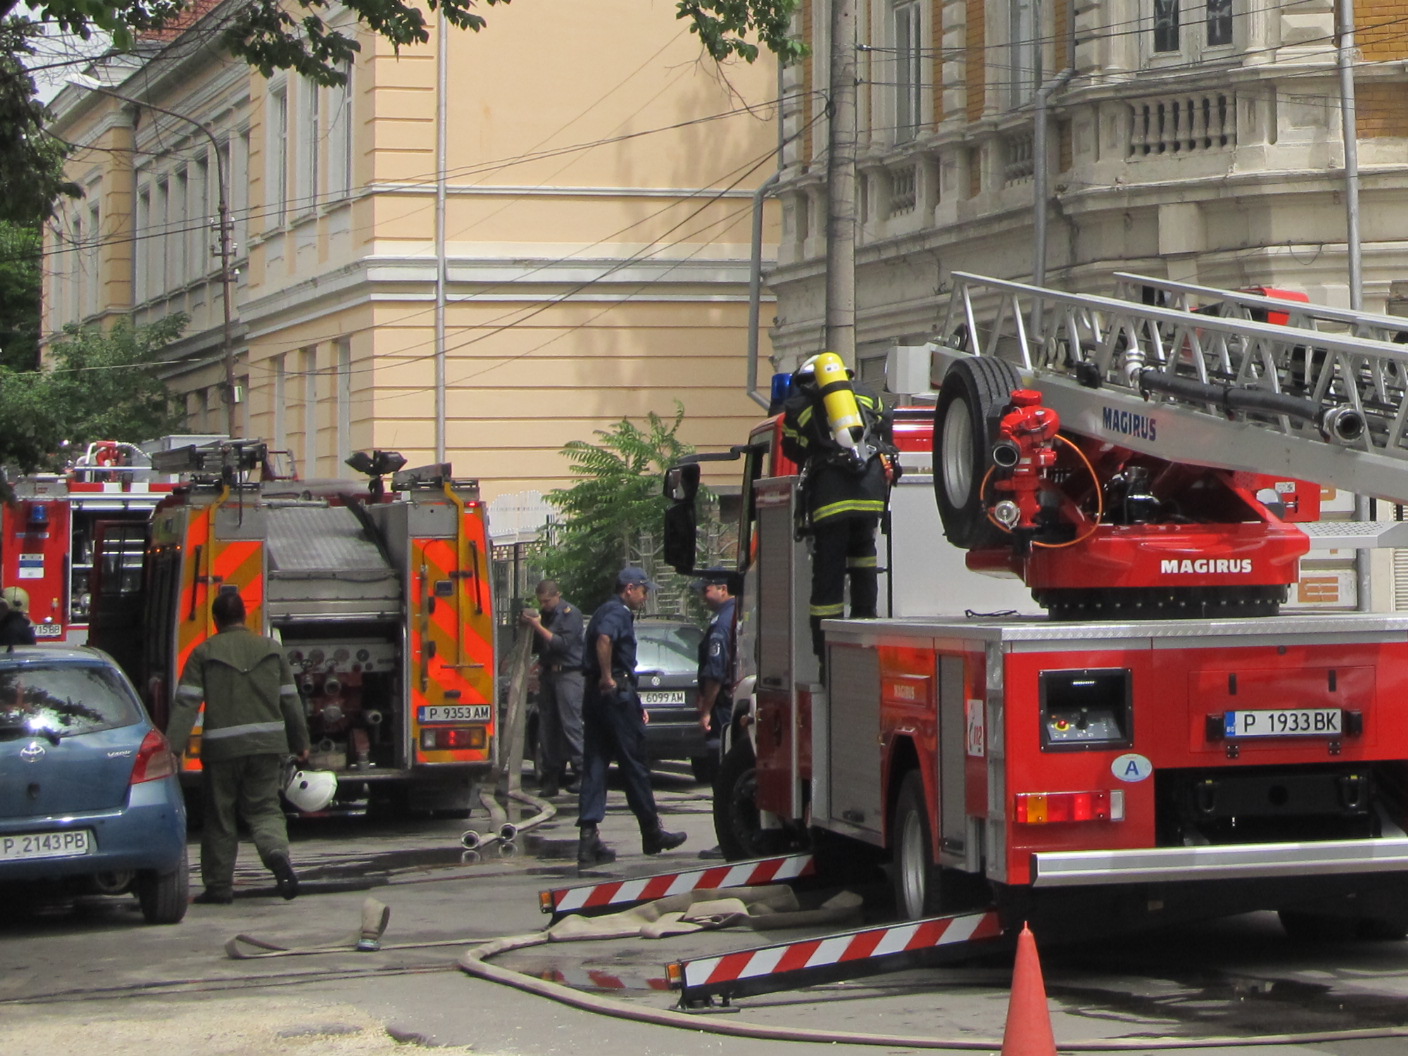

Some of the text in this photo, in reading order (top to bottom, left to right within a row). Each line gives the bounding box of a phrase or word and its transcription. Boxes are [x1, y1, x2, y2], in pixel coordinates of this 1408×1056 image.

[1102, 406, 1157, 442] MAGIRUS
[1160, 559, 1252, 574] MAGIRUS
[1124, 759, 1140, 776] A
